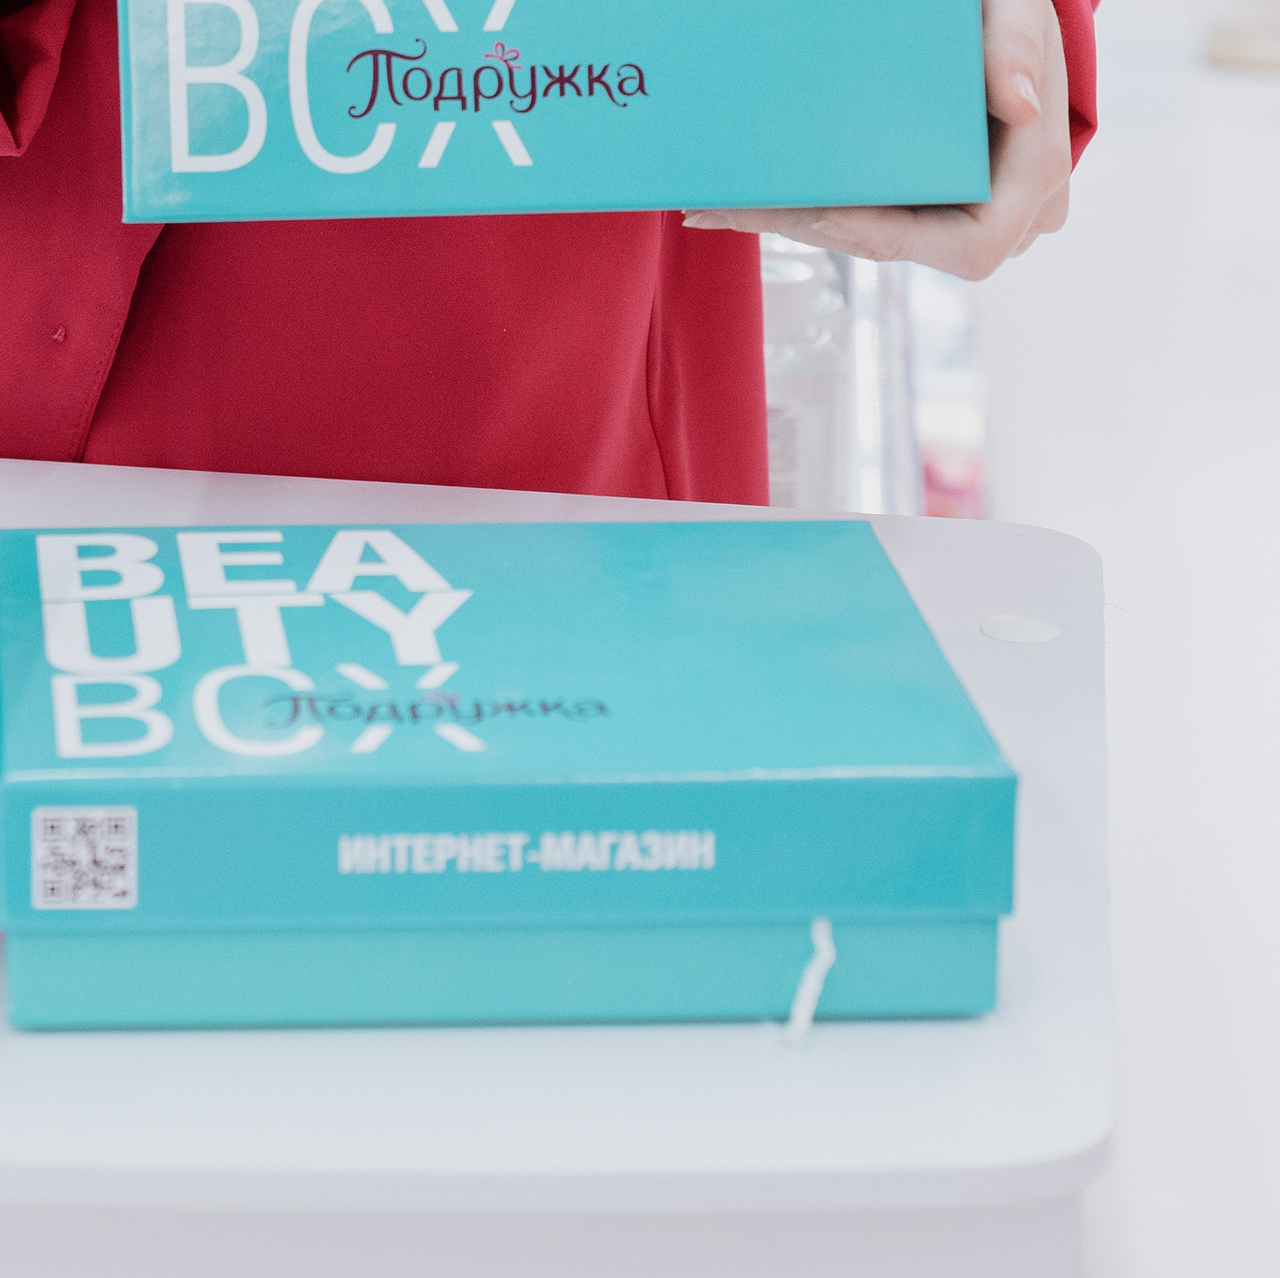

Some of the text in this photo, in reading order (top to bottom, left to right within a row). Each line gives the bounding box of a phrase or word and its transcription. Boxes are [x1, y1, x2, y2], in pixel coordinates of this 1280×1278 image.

[347, 39, 648, 118] Подружка
[35, 529, 452, 603] BEA
[41, 589, 474, 675] UTY
[263, 688, 612, 729] Подружка
[337, 830, 716, 874] ИНТЕРНЕТ-МАГАЗИН
